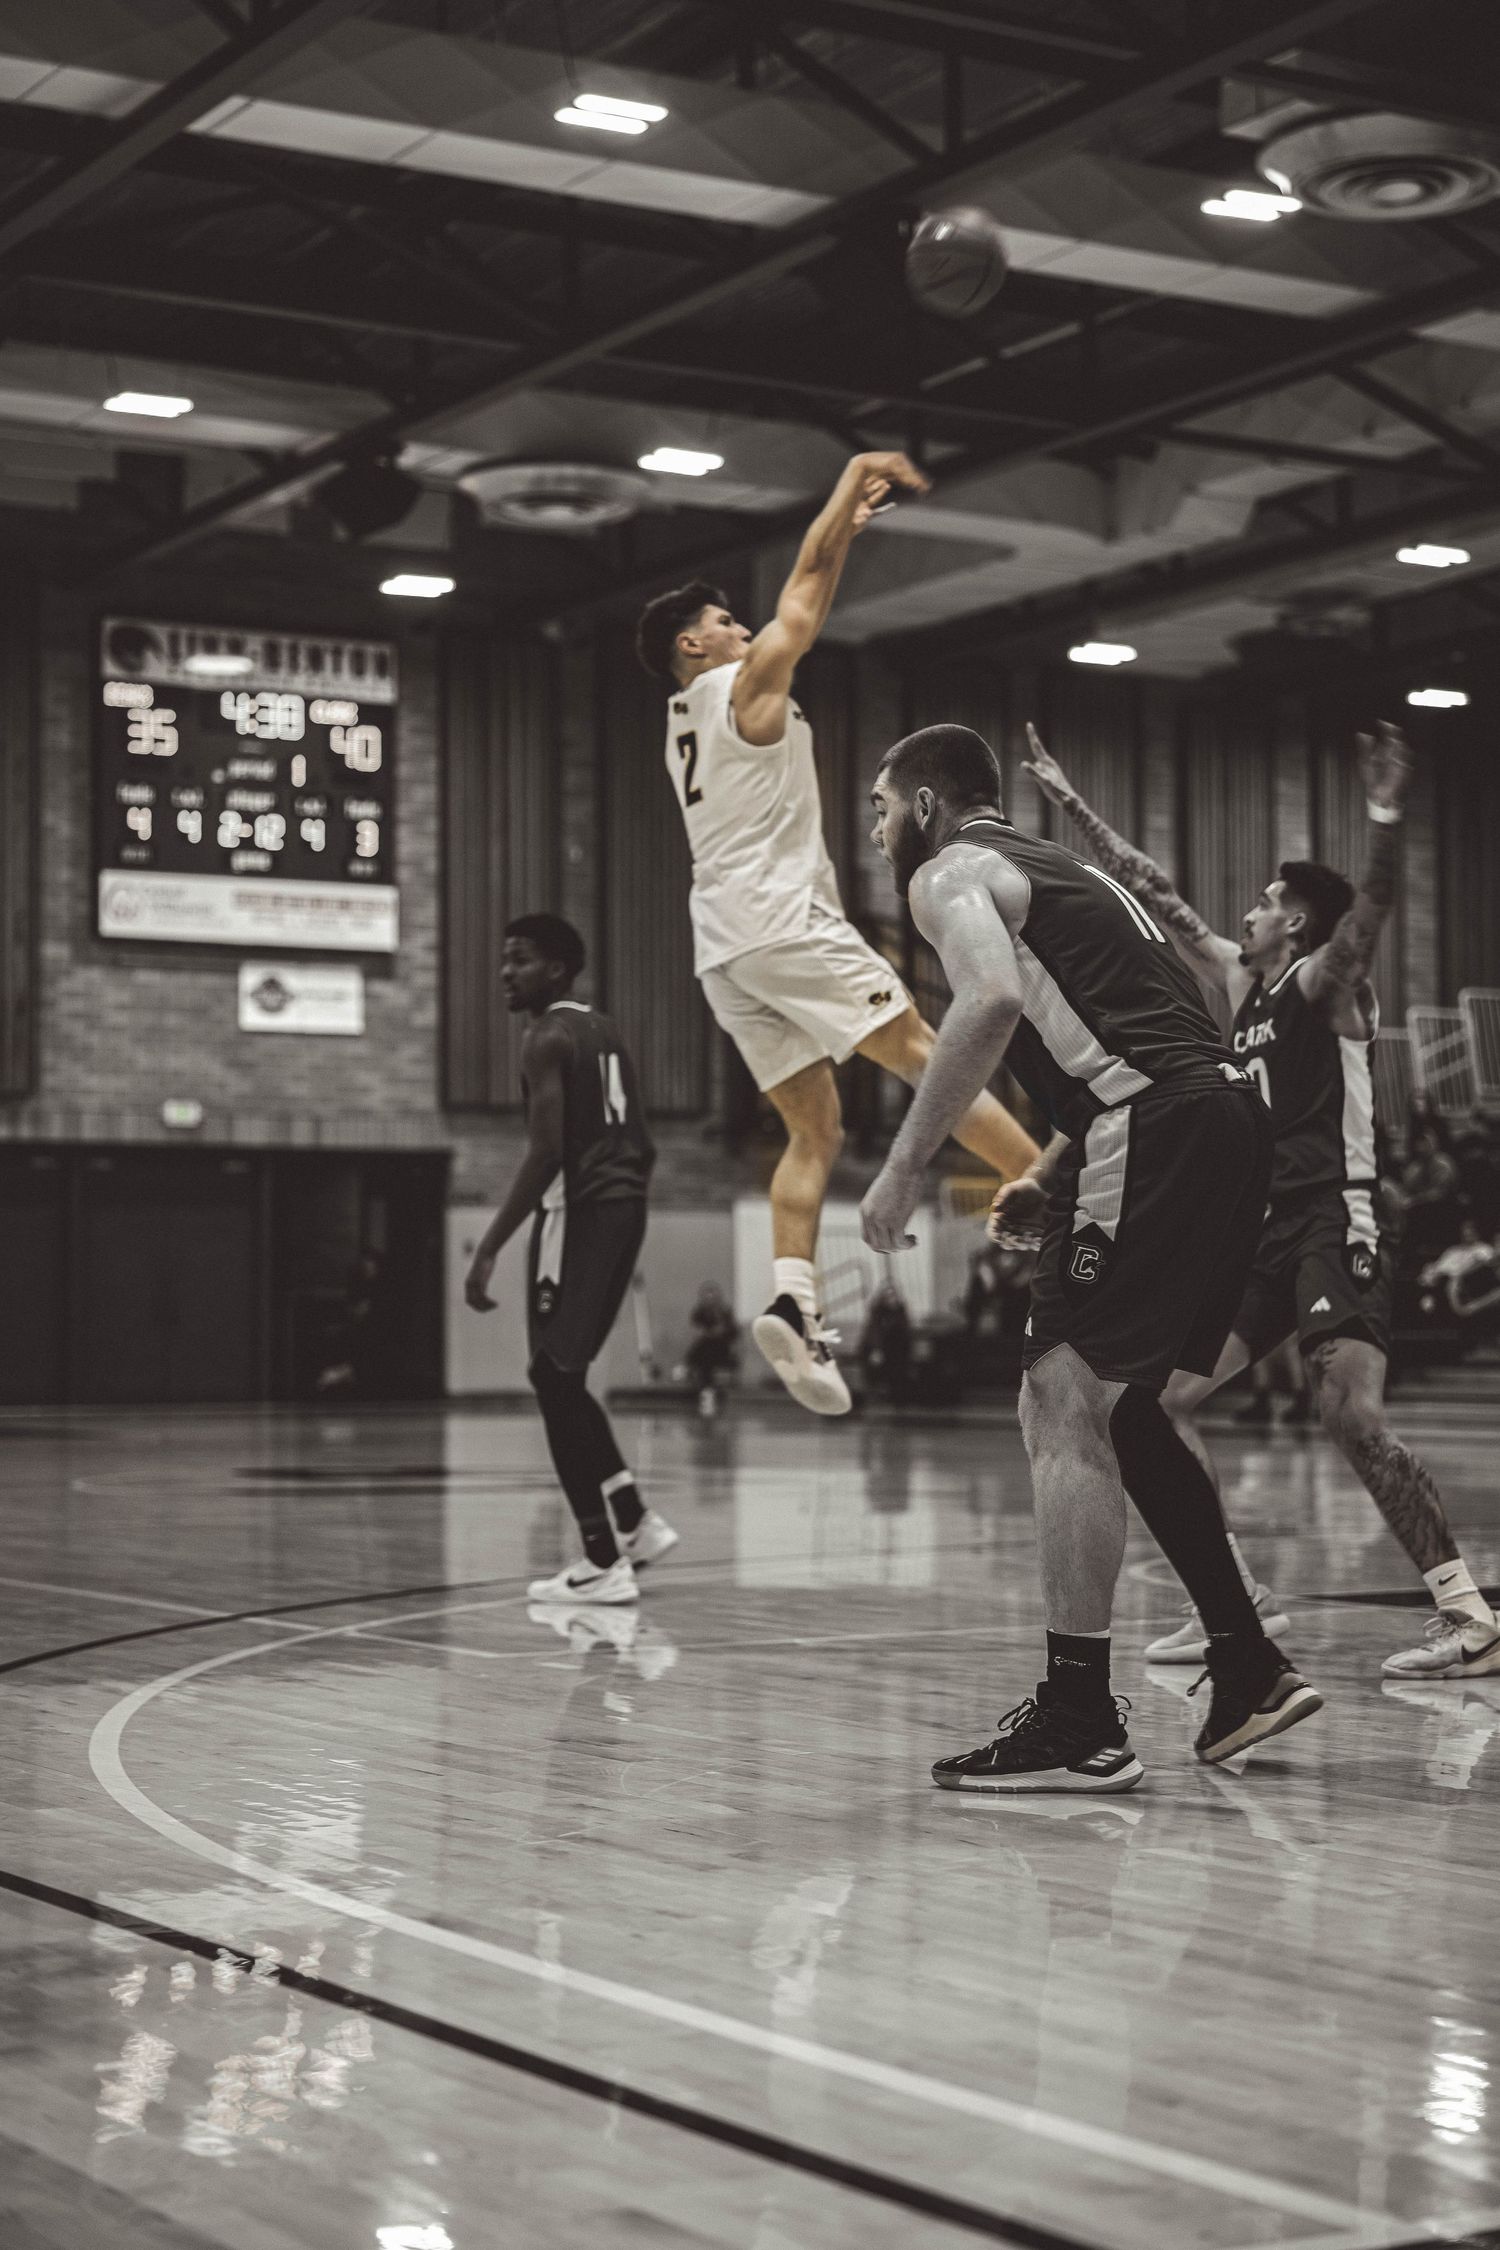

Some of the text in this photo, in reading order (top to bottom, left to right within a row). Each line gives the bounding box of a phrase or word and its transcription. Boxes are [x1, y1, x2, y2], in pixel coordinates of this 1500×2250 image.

[127, 708, 178, 756] 35
[330, 725, 382, 772] 40
[676, 730, 703, 807] 2
